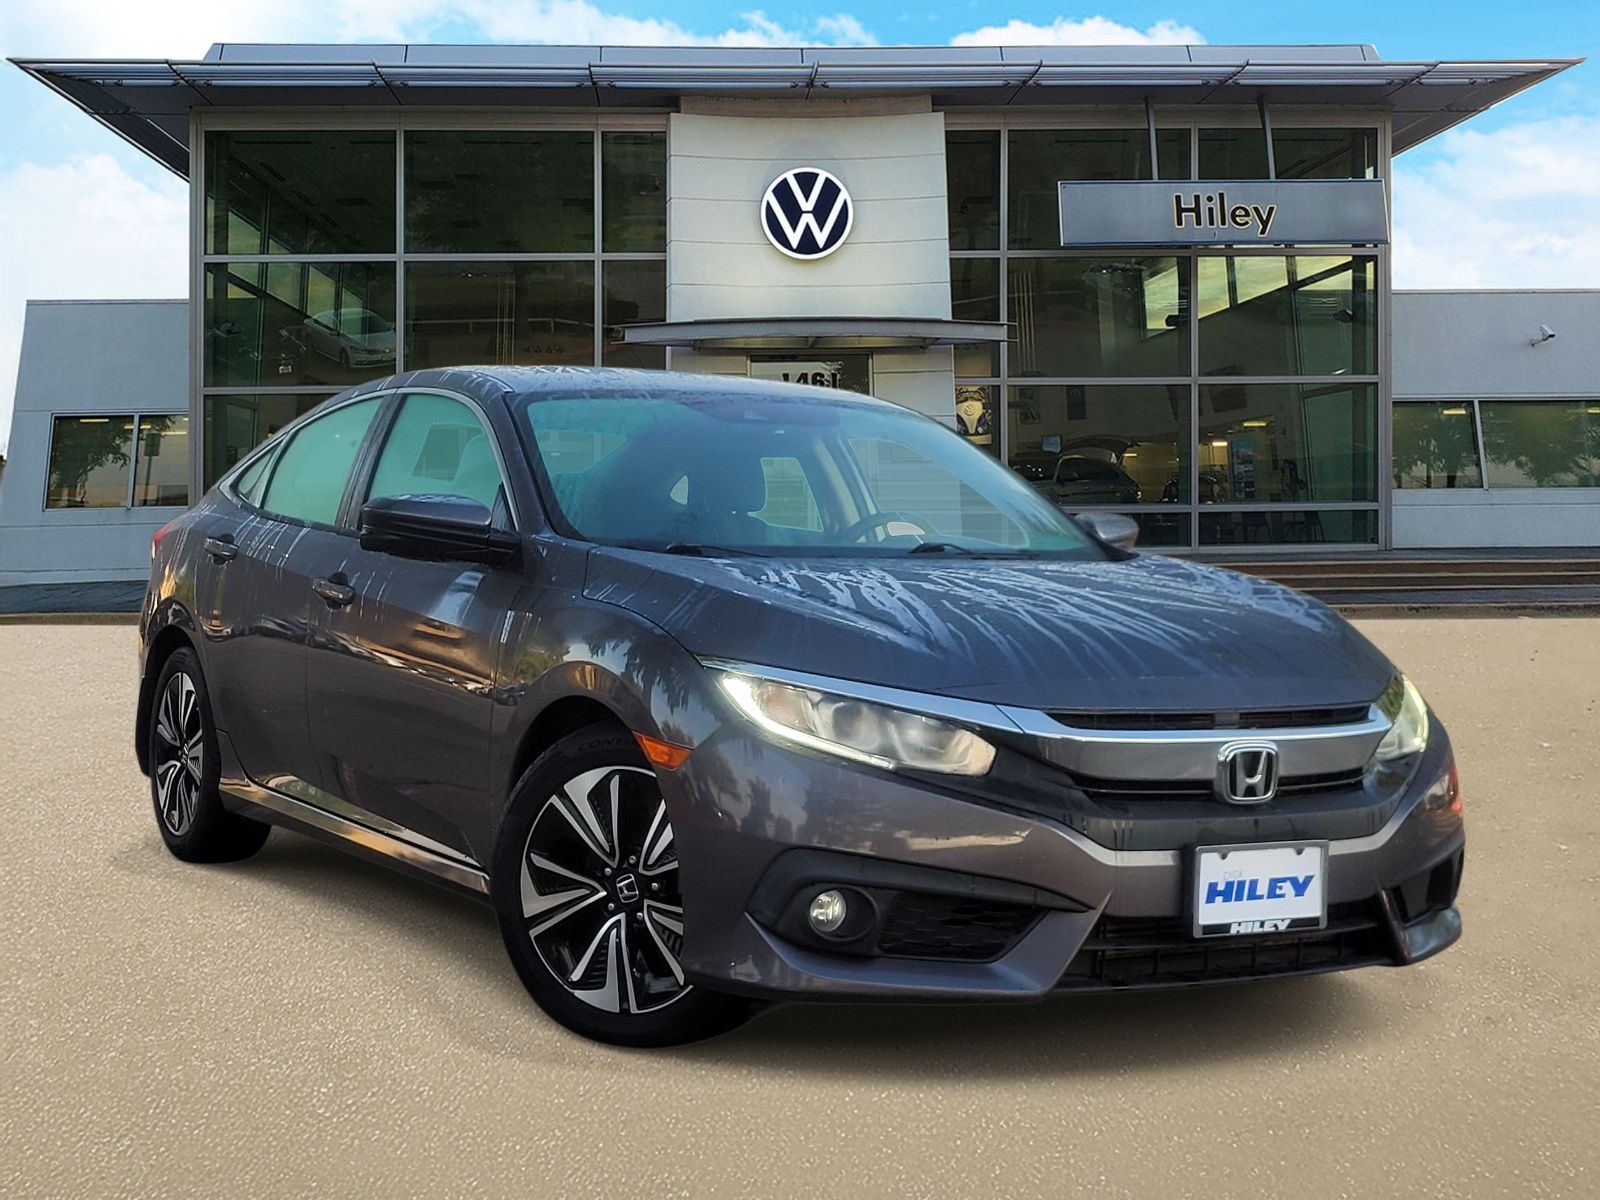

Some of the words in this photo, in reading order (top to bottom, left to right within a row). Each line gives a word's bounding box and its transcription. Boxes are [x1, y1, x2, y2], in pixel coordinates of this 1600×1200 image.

[1174, 191, 1276, 236] Hiley
[1205, 874, 1315, 904] HILEY
[1229, 918, 1292, 934] HILEY
